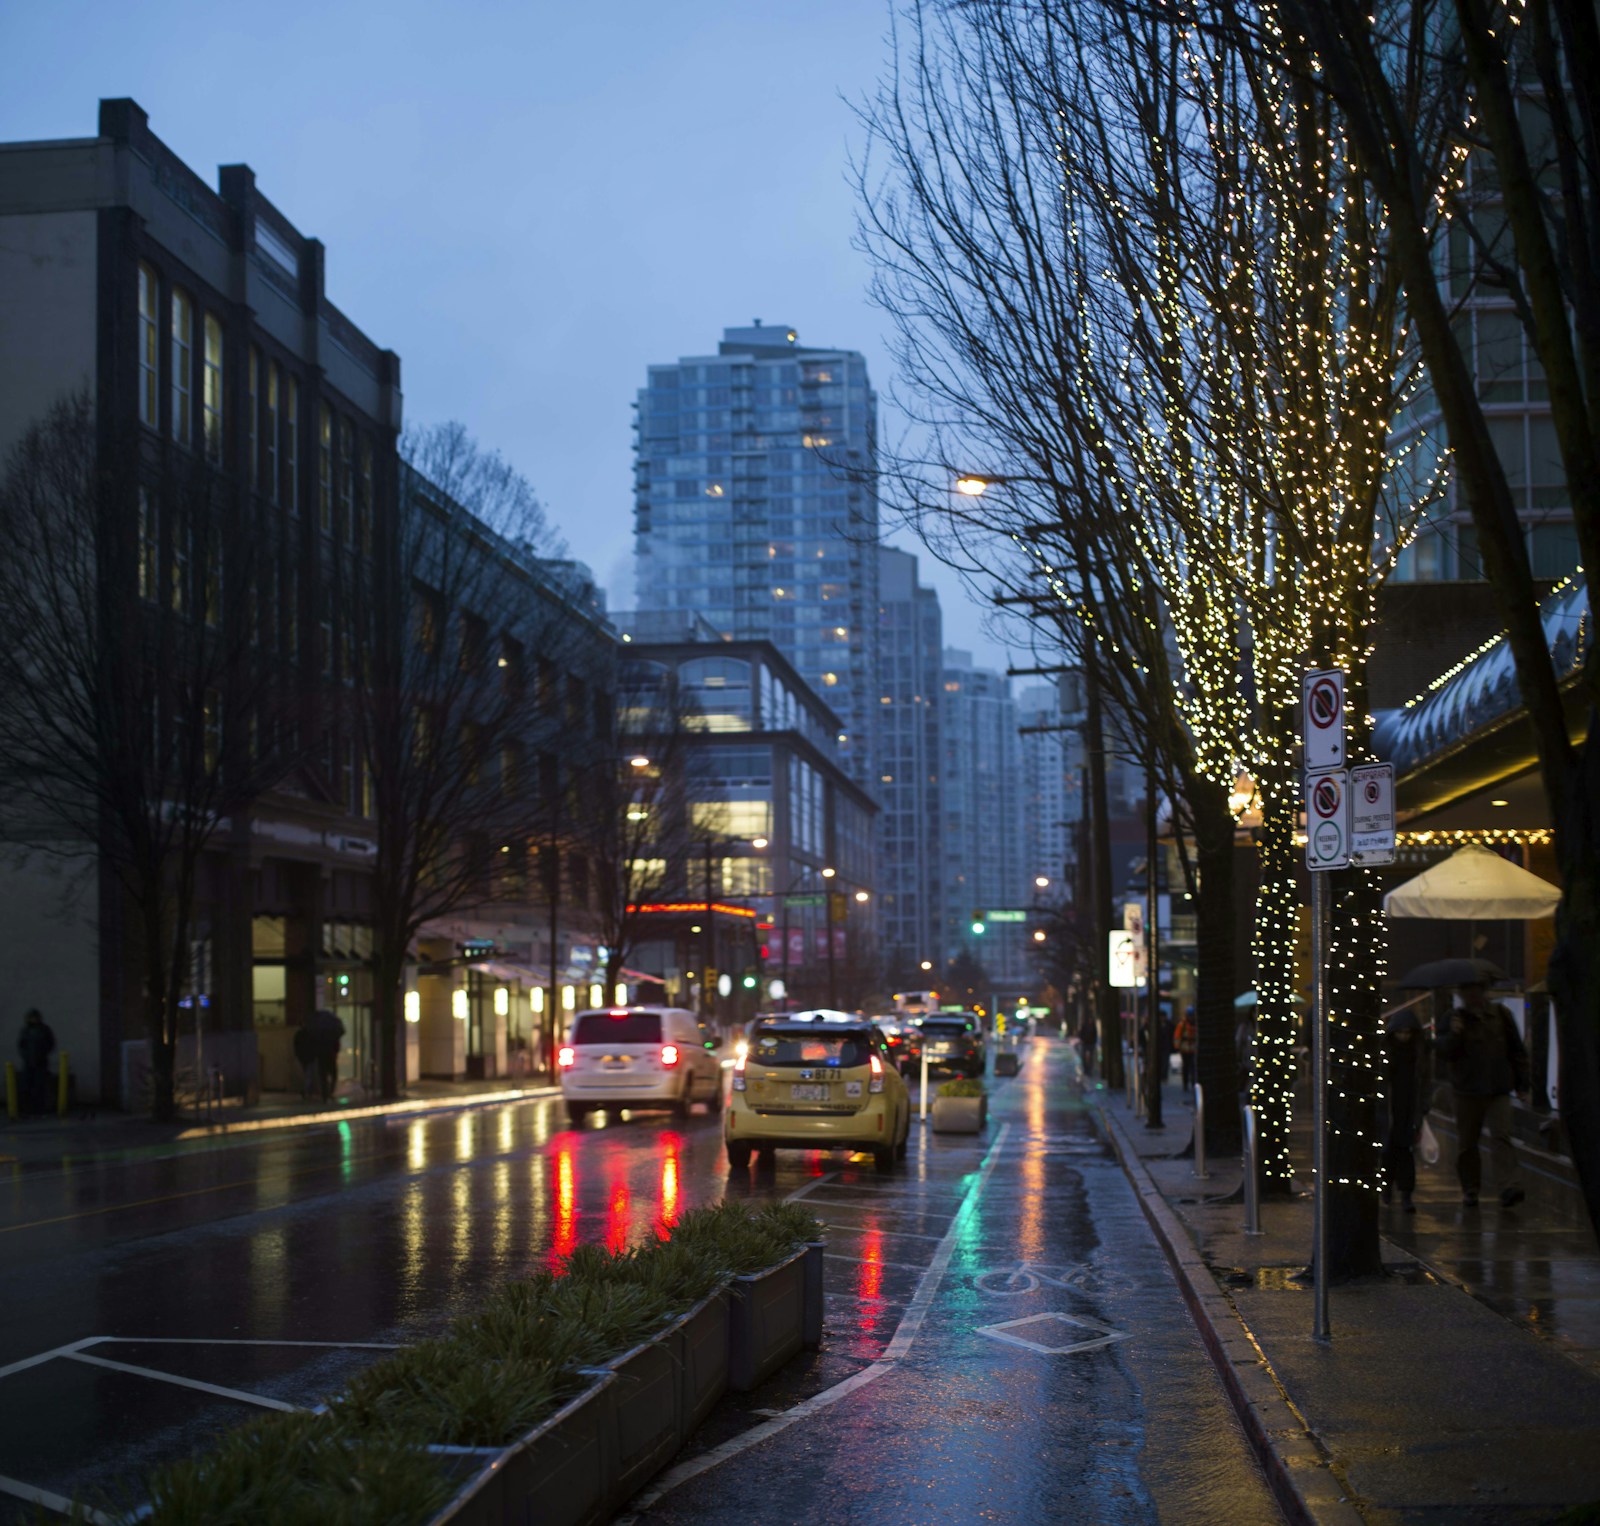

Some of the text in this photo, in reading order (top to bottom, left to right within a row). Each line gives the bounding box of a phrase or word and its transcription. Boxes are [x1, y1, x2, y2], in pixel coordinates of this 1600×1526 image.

[1354, 769, 1391, 781] TEMPORARY
[1354, 813, 1390, 823] DURING POSTED
[815, 1069, 841, 1079] BT 71
